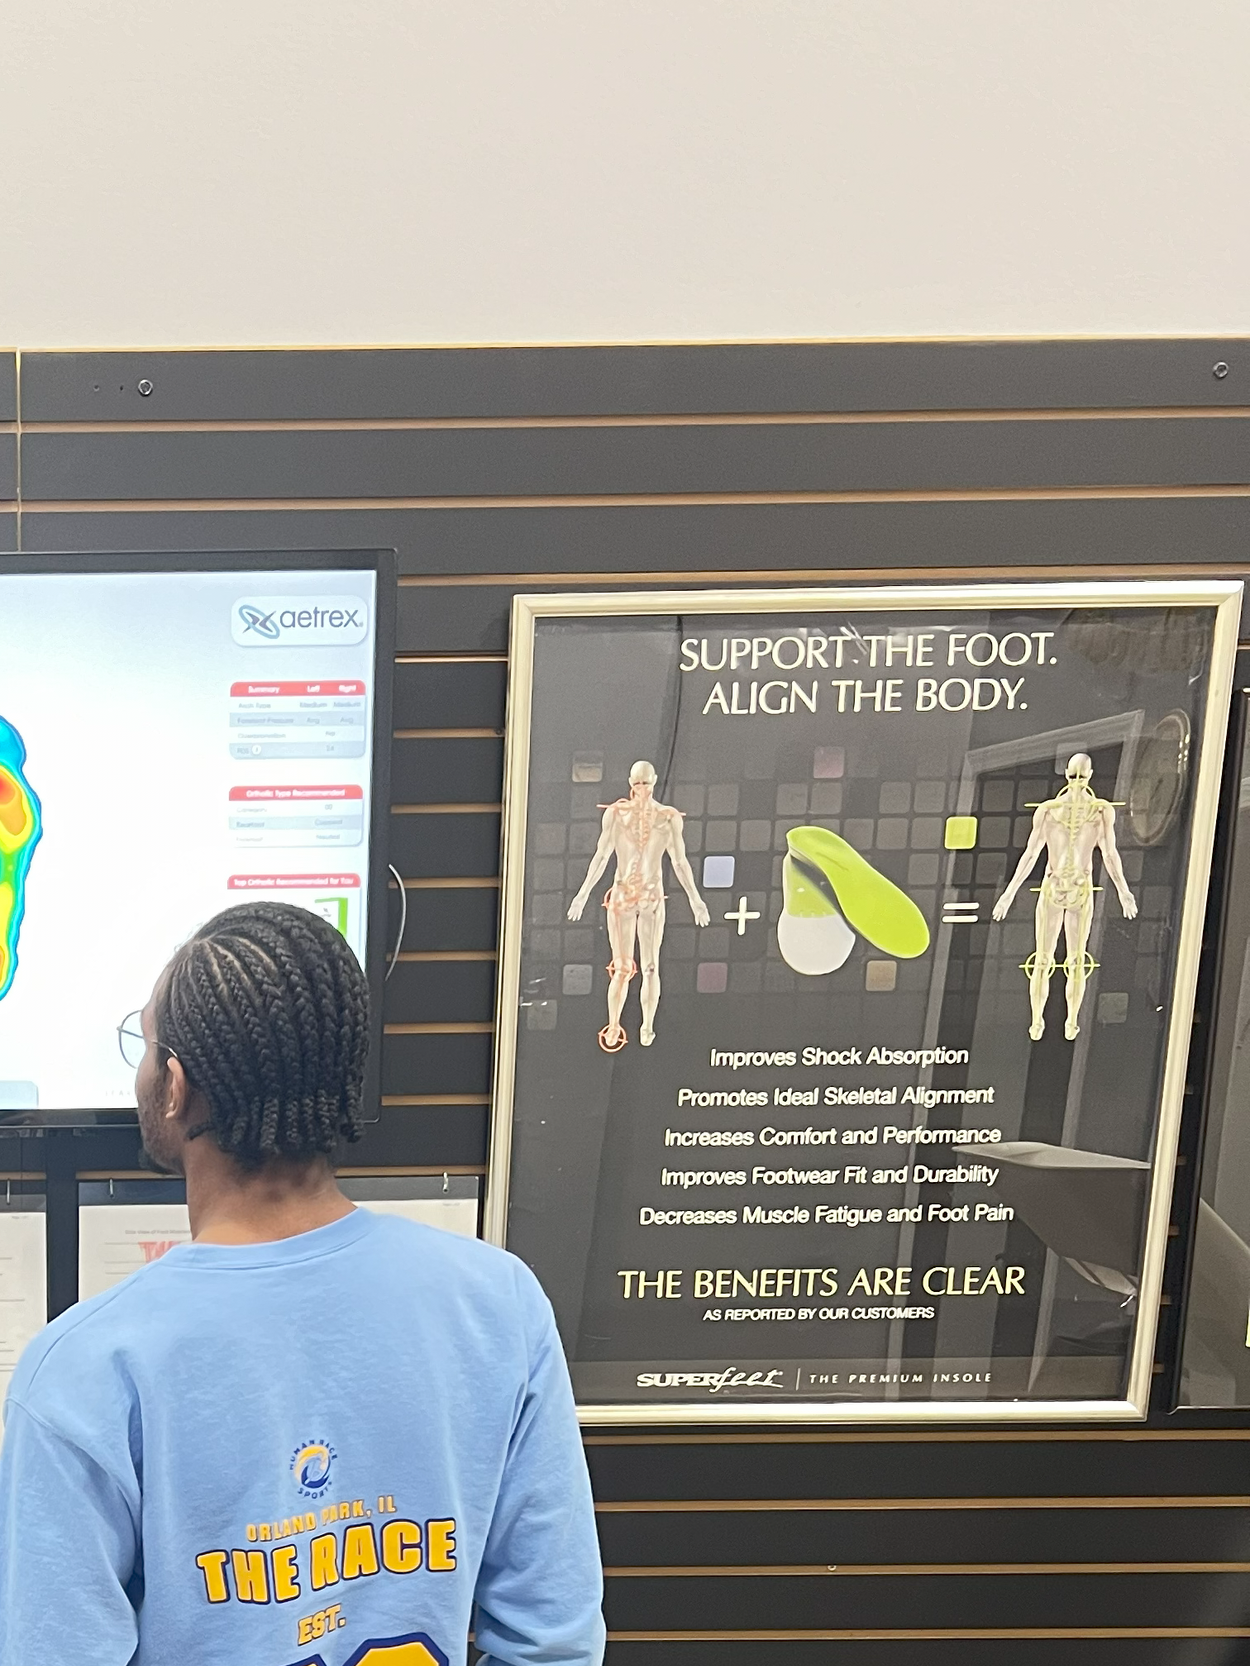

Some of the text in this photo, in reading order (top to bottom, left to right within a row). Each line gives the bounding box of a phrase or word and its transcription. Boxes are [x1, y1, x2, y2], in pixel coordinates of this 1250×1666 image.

[280, 607, 359, 628] aetrex
[679, 631, 1058, 671] SUPPORT THE FOOT.
[702, 677, 1028, 715] ALIGN THE BODY.
[710, 1047, 969, 1070] Improves Shock Absorption
[678, 1086, 994, 1108] Promotes Ideal Skeletal Alignment
[664, 1126, 1002, 1147] Increases Comfort and Performance
[660, 1164, 999, 1189] Improves Footwear Fit and Durability
[640, 1203, 1014, 1227] Decreases Muscle Fatigue and Foot Pain
[617, 1266, 1026, 1299] THE BENEFITS ARE CLEAR
[702, 1307, 935, 1321] AS REPORTED BY OUR CUSTOMERS
[636, 1367, 993, 1393] SUPERfeet THE PREMIUM INSOLE
[246, 1495, 397, 1542] ORLAND PARK, IL
[196, 1518, 457, 1605] THE RACE
[298, 1603, 346, 1646] EST.
